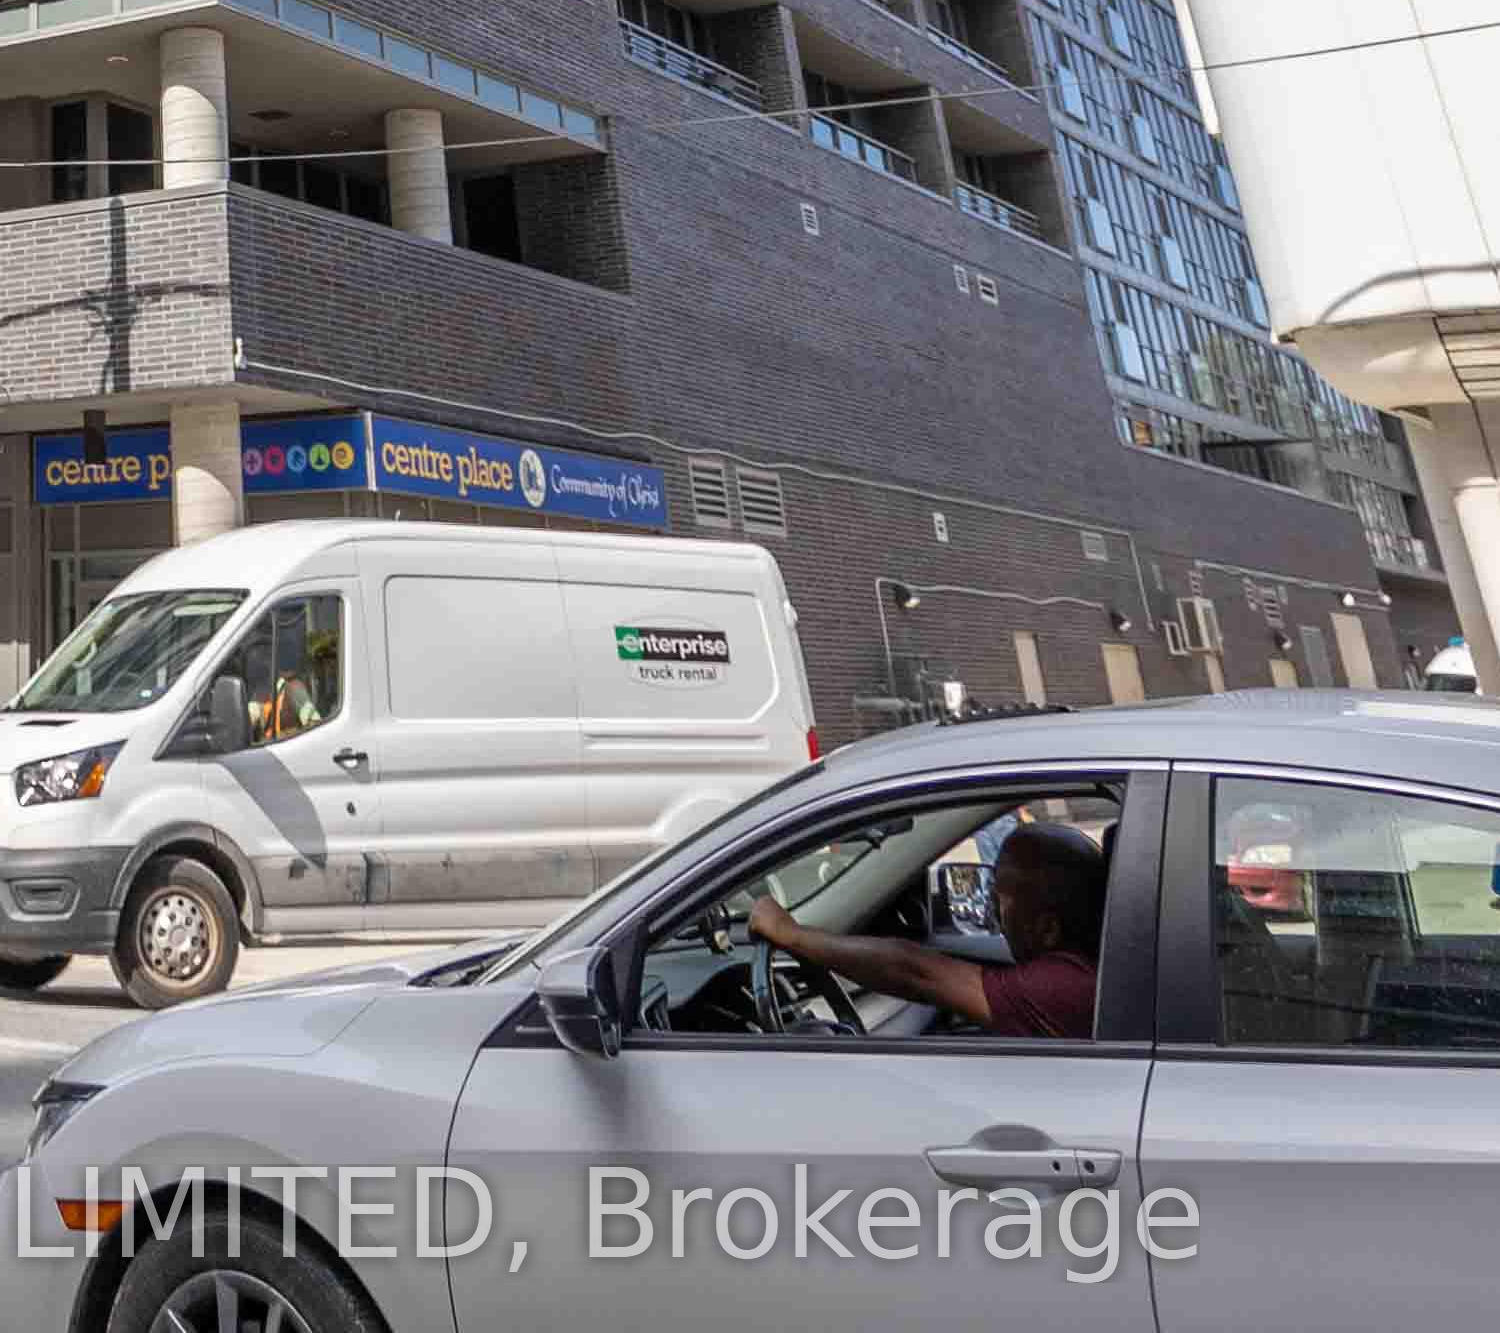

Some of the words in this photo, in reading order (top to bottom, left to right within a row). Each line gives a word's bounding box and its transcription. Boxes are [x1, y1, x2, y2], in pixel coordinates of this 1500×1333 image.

[382, 441, 453, 482] centre
[456, 446, 513, 496] place
[551, 463, 616, 518] Community
[622, 633, 728, 659] enterprise
[638, 665, 675, 680] truck
[678, 667, 718, 680] rental
